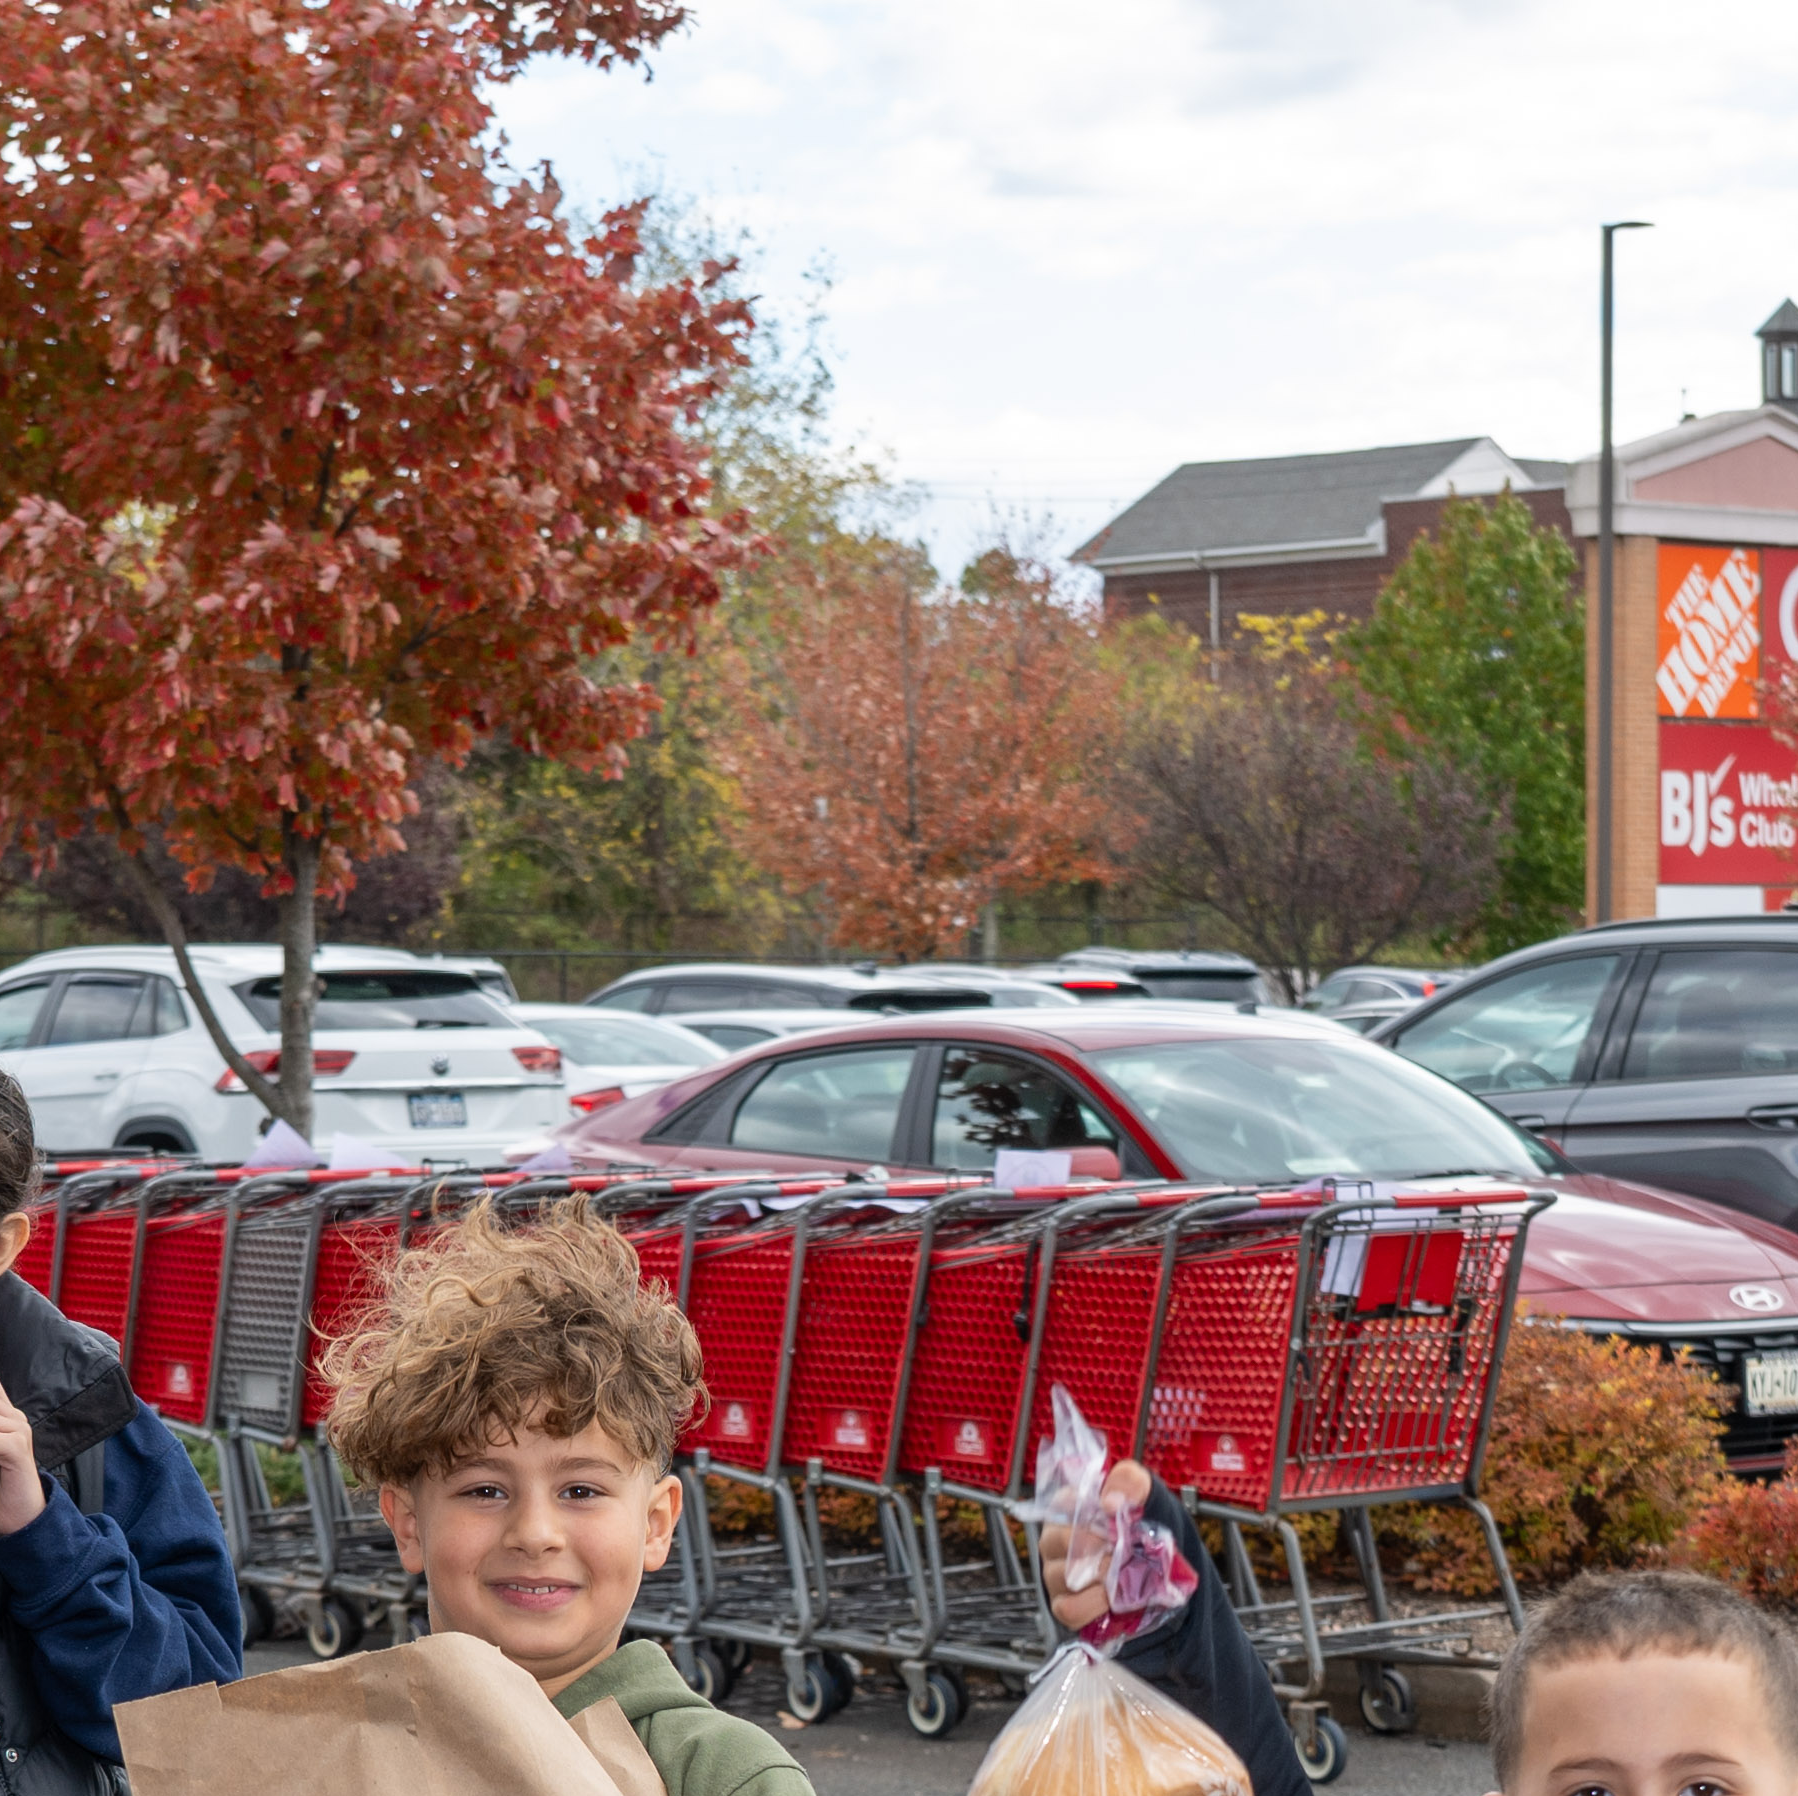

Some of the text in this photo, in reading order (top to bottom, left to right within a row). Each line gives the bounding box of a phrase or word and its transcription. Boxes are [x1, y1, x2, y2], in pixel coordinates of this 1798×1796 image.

[1655, 547, 1761, 717] HOME
[1664, 563, 1710, 627] THE
[1696, 611, 1761, 718] DEPOT
[1739, 811, 1797, 848] Club
